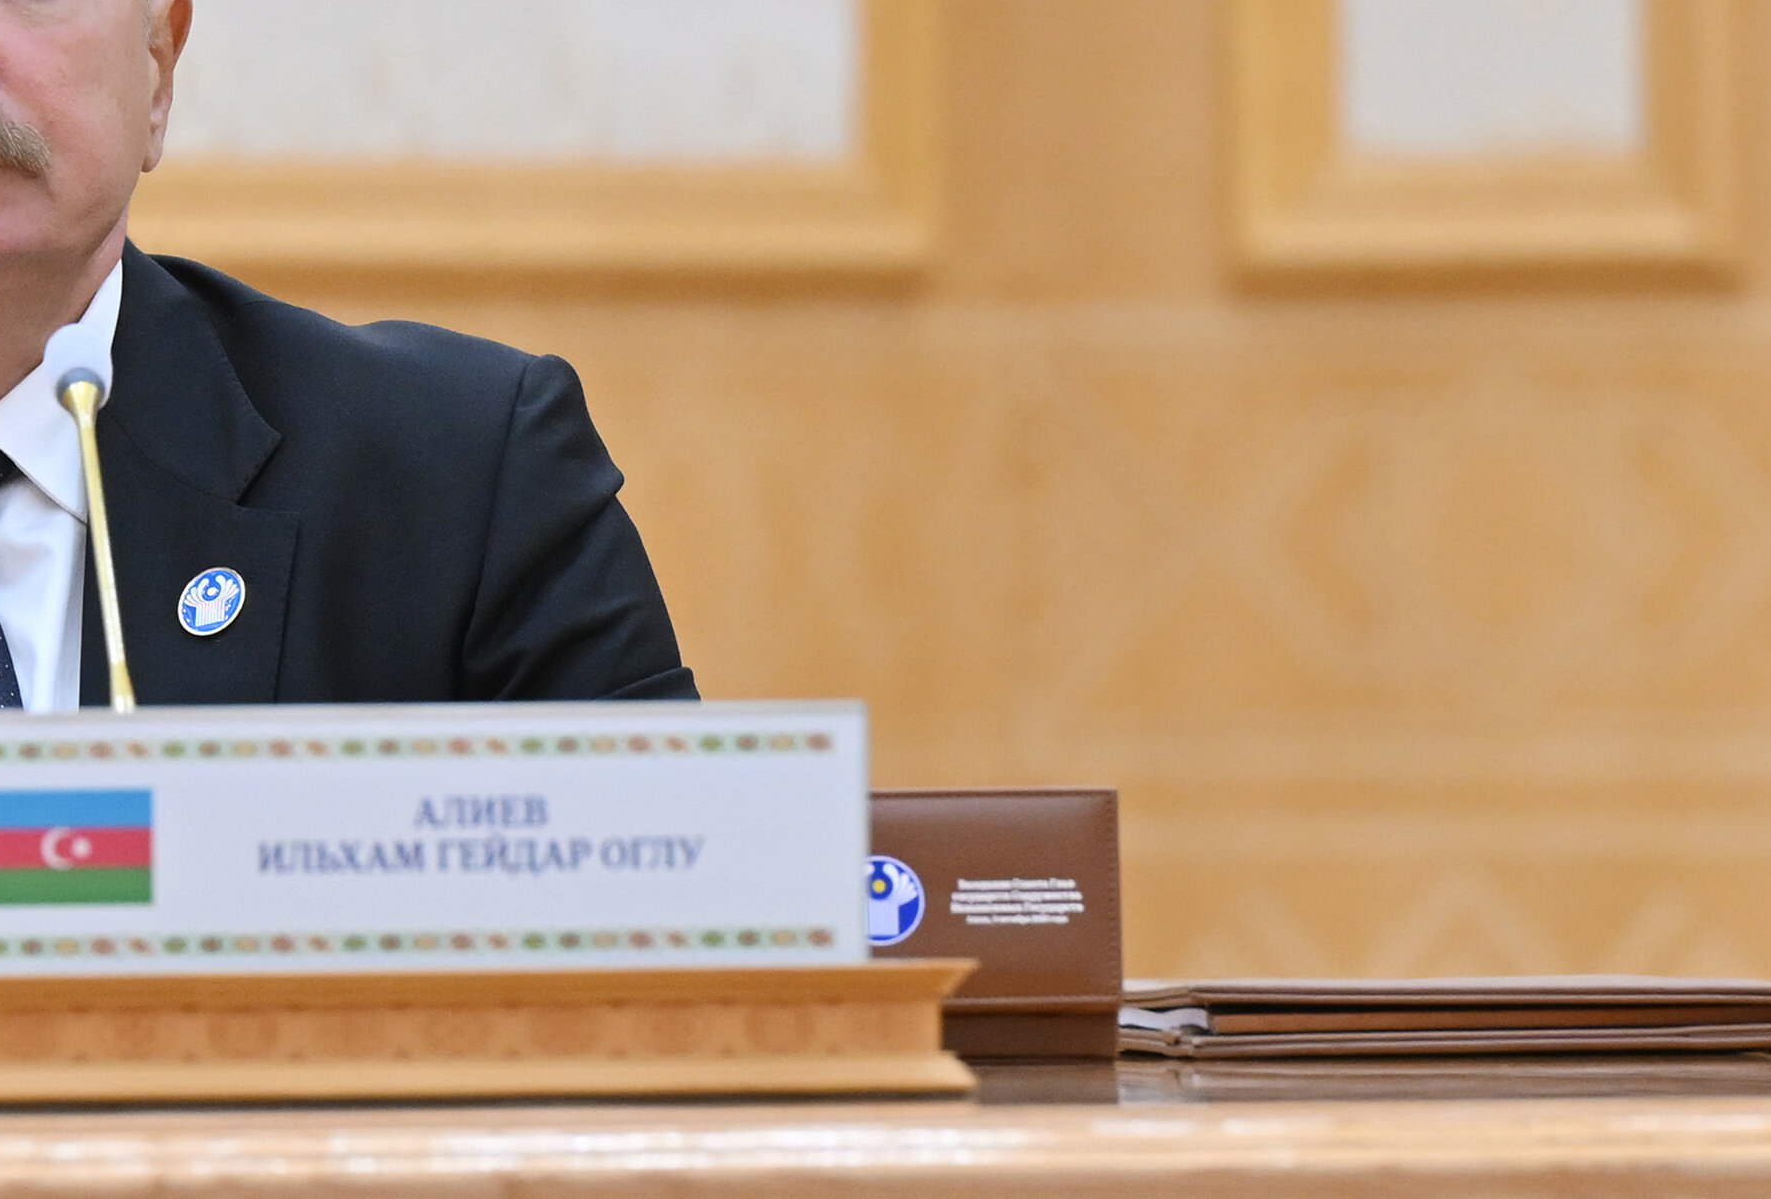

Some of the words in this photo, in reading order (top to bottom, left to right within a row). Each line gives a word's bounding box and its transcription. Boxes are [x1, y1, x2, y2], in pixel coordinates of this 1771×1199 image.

[414, 795, 549, 827] АЛИЕВ
[258, 839, 426, 874] ИЛЬХАМ
[436, 833, 593, 876] ГЕЙДАР
[599, 835, 705, 871] ОГЛУ
